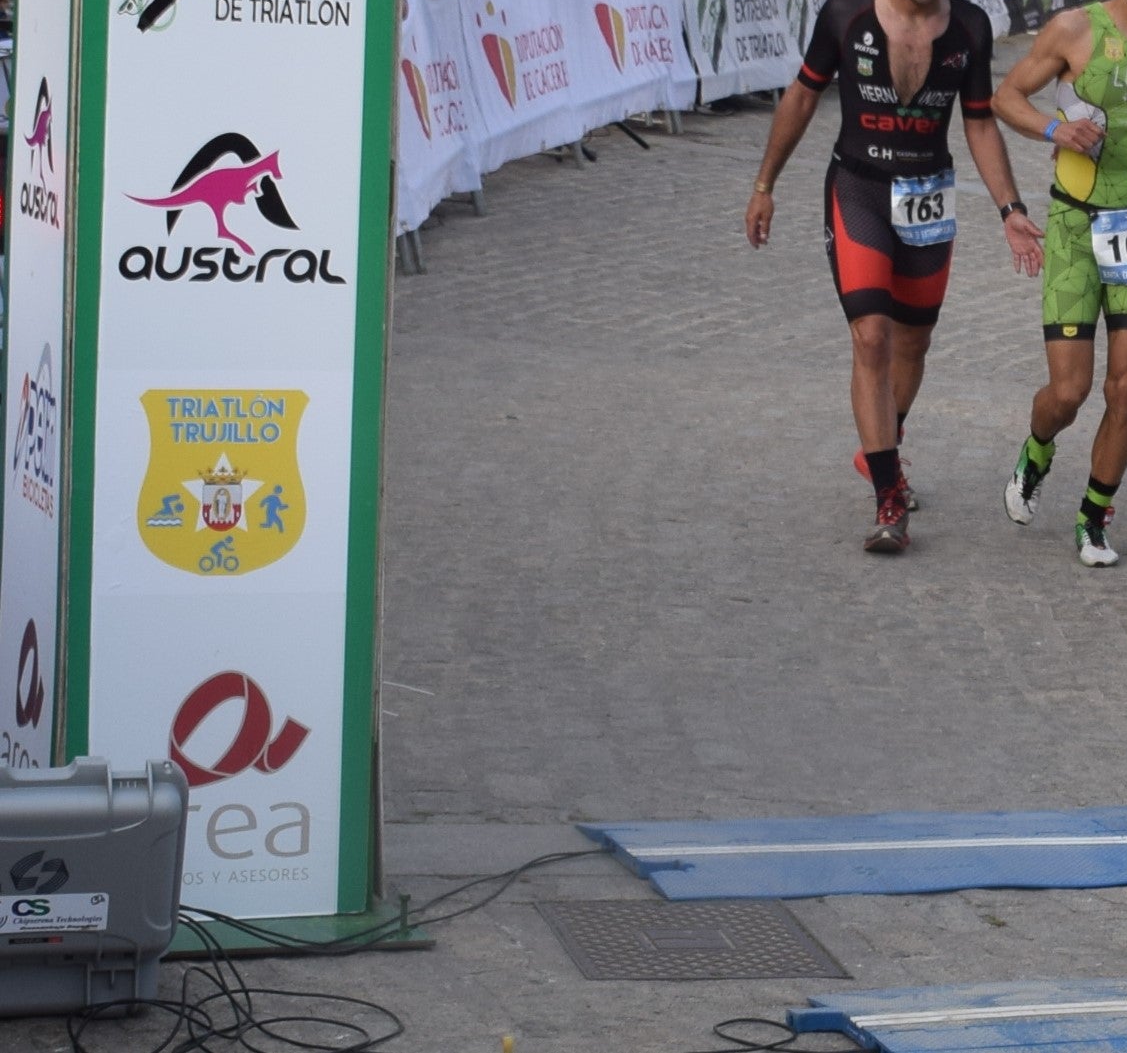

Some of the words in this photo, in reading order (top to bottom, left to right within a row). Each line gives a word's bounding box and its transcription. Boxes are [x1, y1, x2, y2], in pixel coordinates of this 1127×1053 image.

[904, 191, 945, 225] 163
[119, 246, 347, 285] austral
[166, 391, 285, 419] TRIATLÓN
[170, 422, 281, 444] TRUJILLO
[227, 867, 309, 884] ASESORES
